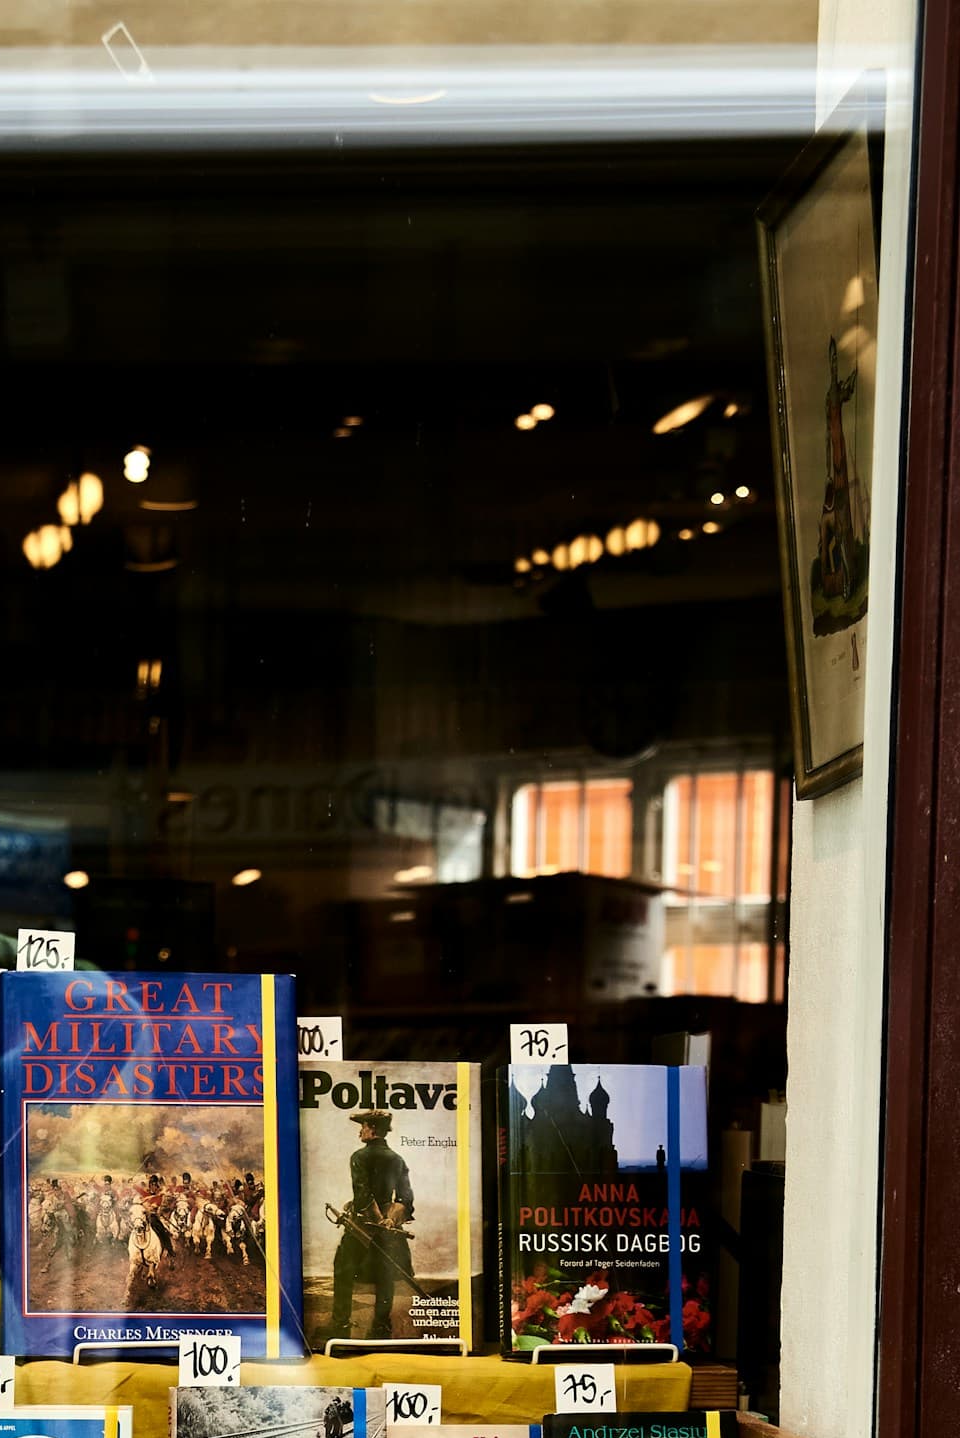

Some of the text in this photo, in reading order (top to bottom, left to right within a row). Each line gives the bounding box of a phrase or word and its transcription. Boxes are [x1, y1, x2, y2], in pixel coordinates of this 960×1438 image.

[64, 981, 233, 1014] GREAT
[22, 1021, 265, 1055] MILITARY
[22, 1063, 266, 1098] DISASTERS
[400, 1136, 426, 1148] Peter
[578, 1183, 640, 1203] ANNA
[518, 1233, 608, 1252] RUSSISK
[560, 1259, 583, 1267] Forord
[615, 1259, 660, 1268] Seidenfaden
[73, 1326, 141, 1341] CHARLES
